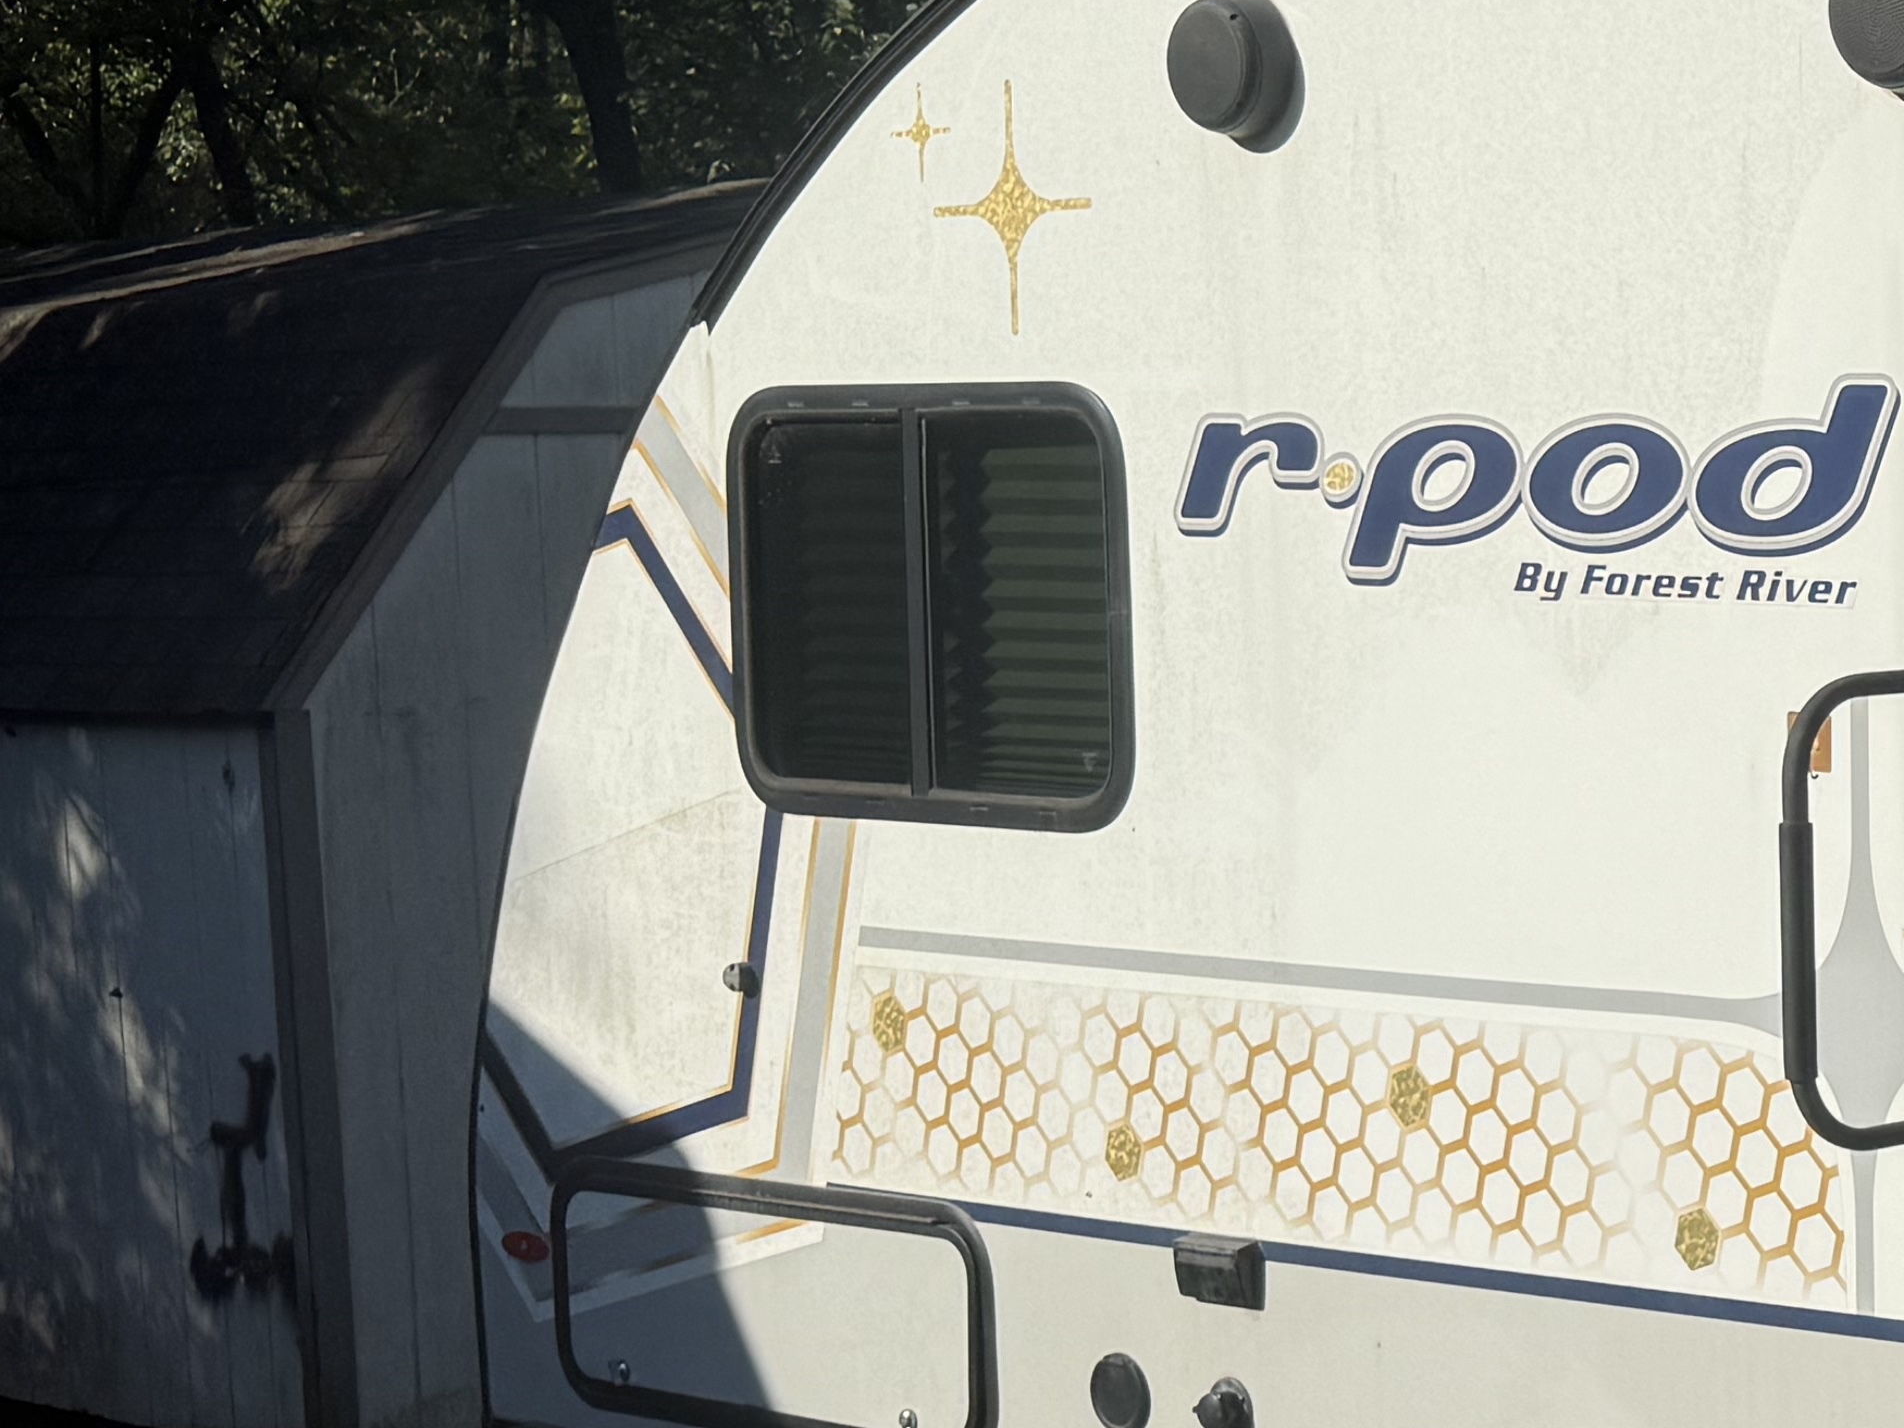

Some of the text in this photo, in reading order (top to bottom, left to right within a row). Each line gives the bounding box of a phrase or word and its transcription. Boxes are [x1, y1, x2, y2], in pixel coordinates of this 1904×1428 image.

[1512, 561, 1858, 606] By Forest River
